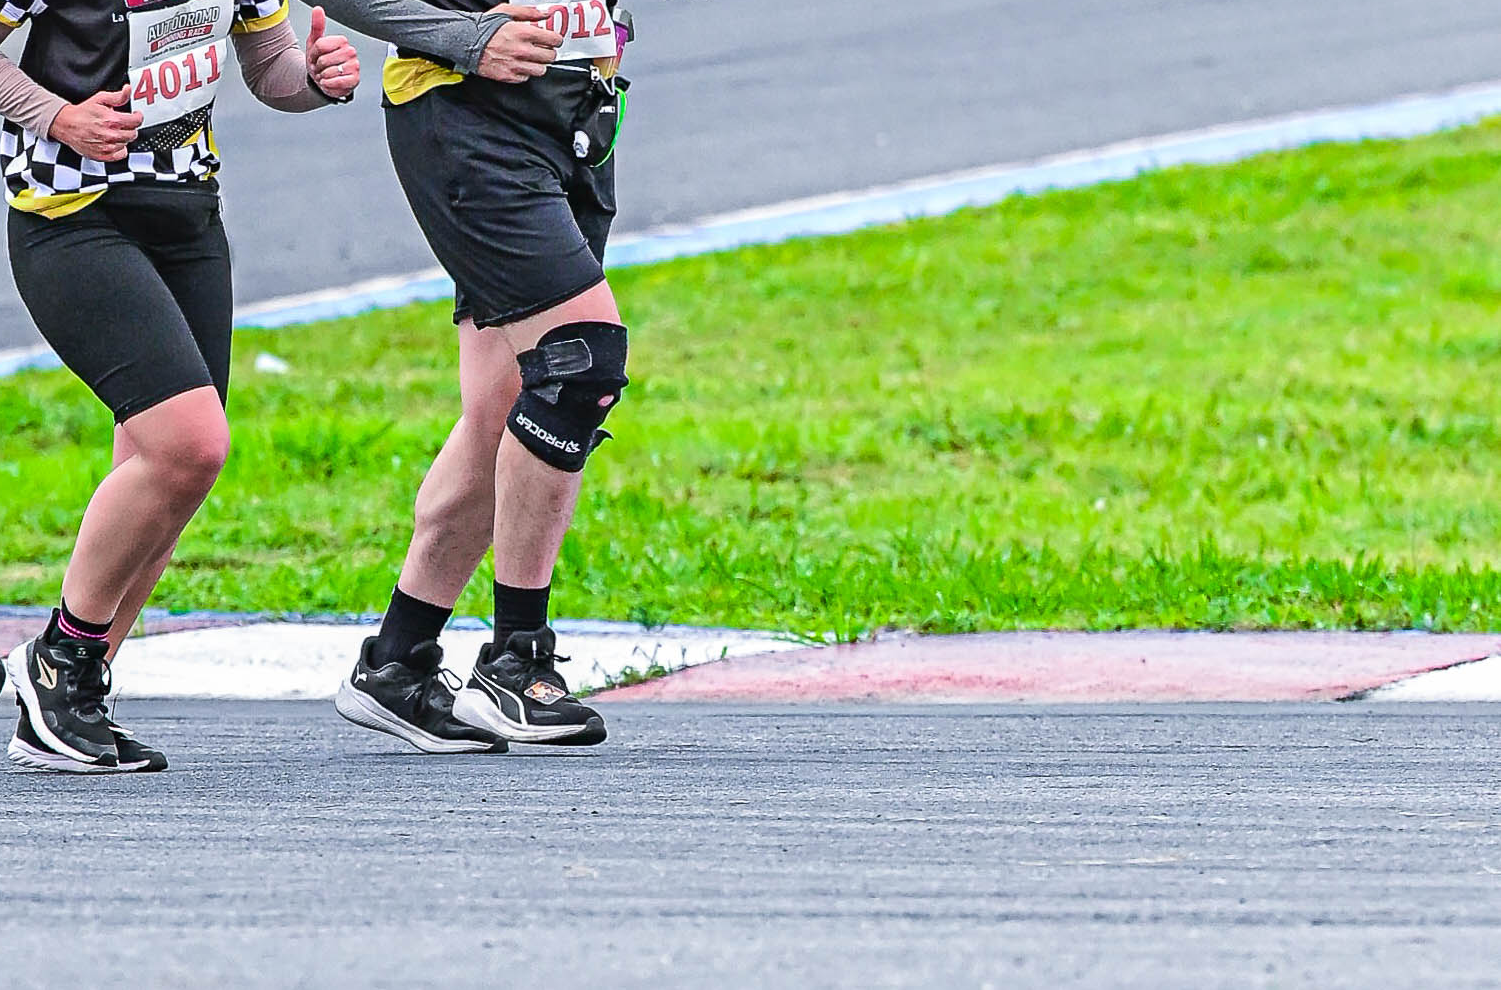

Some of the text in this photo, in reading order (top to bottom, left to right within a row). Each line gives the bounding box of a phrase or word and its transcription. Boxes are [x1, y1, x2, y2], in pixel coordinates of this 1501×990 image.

[112, 13, 124, 23] La
[147, 6, 220, 43] AUTÓDROMO
[530, 0, 611, 39] 012
[134, 45, 220, 105] 4011
[516, 412, 567, 450] PROCER
